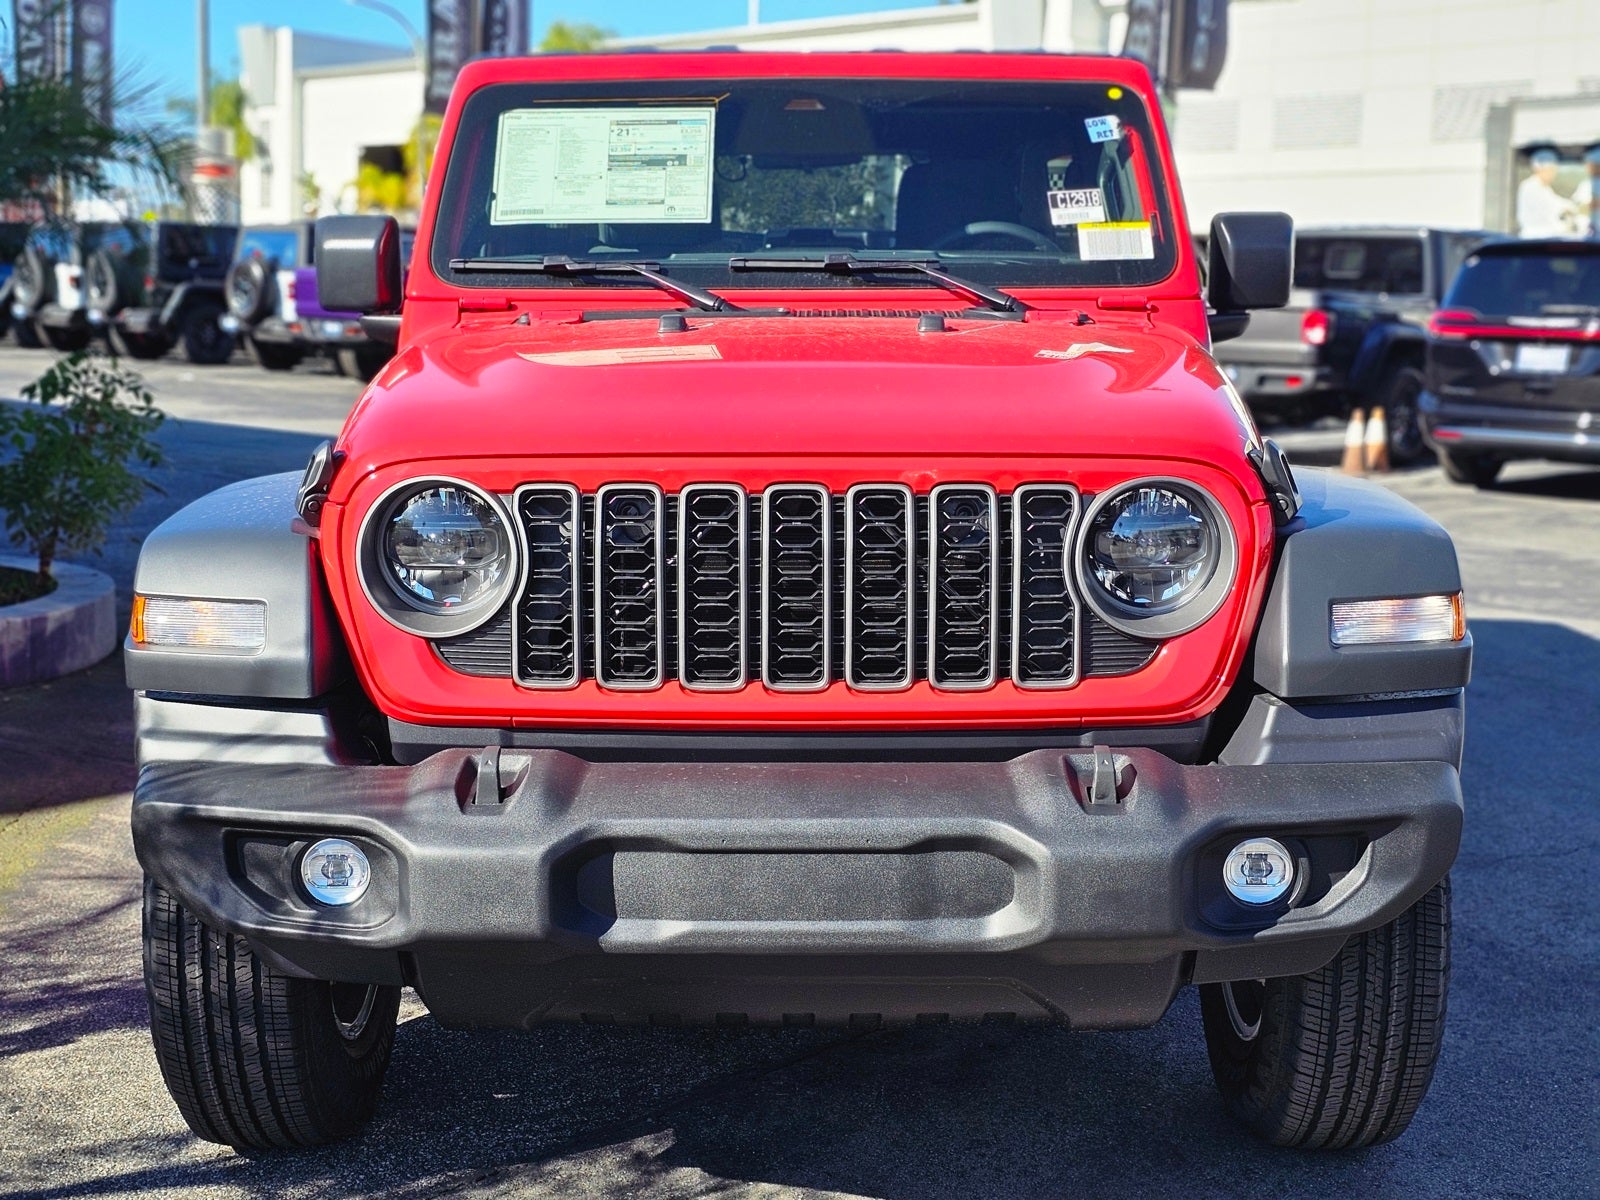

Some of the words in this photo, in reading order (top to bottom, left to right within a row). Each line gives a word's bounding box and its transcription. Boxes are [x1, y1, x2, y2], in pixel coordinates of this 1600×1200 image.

[1086, 118, 1107, 128] LOW
[616, 127, 630, 137] 21
[1096, 129, 1115, 139] RET
[1056, 190, 1101, 209] C12918
